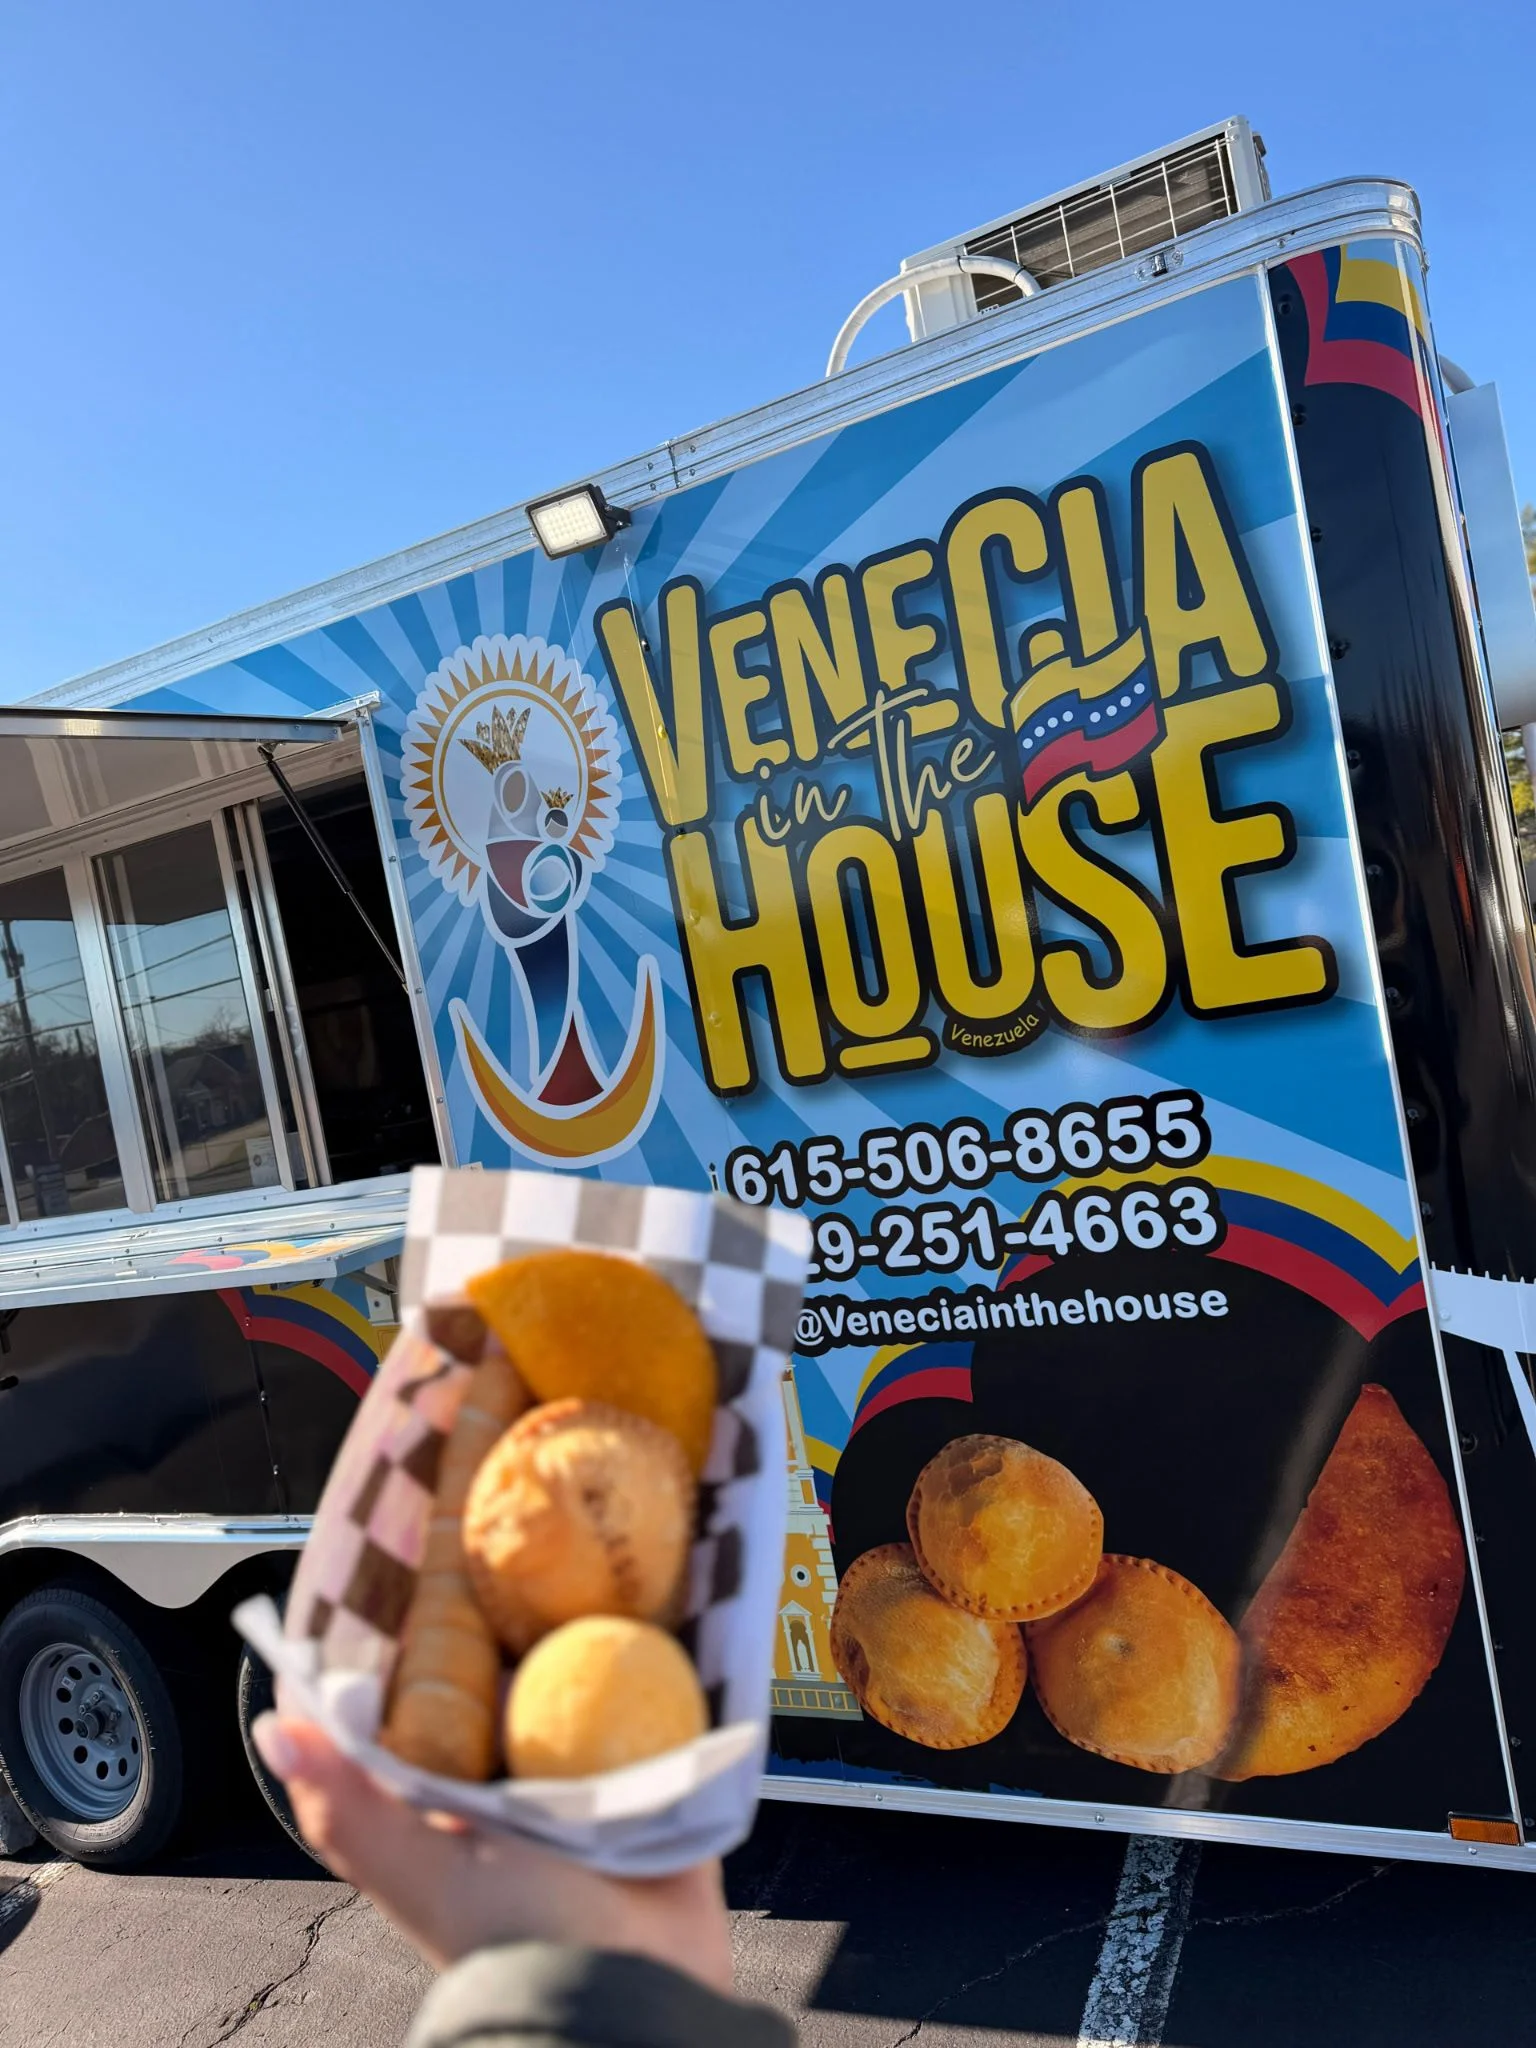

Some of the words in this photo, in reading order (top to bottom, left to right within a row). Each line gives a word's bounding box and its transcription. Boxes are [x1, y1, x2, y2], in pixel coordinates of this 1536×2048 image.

[598, 447, 1271, 825] VENECIA
[754, 766, 849, 841] in
[669, 682, 1329, 1091] HOUSE
[951, 1014, 1039, 1048] Venezuela
[732, 1098, 1202, 1205] 615-506-8655
[808, 1185, 1217, 1275] 9-251-4663
[795, 1288, 1229, 1346] @Veneciainthehouse
